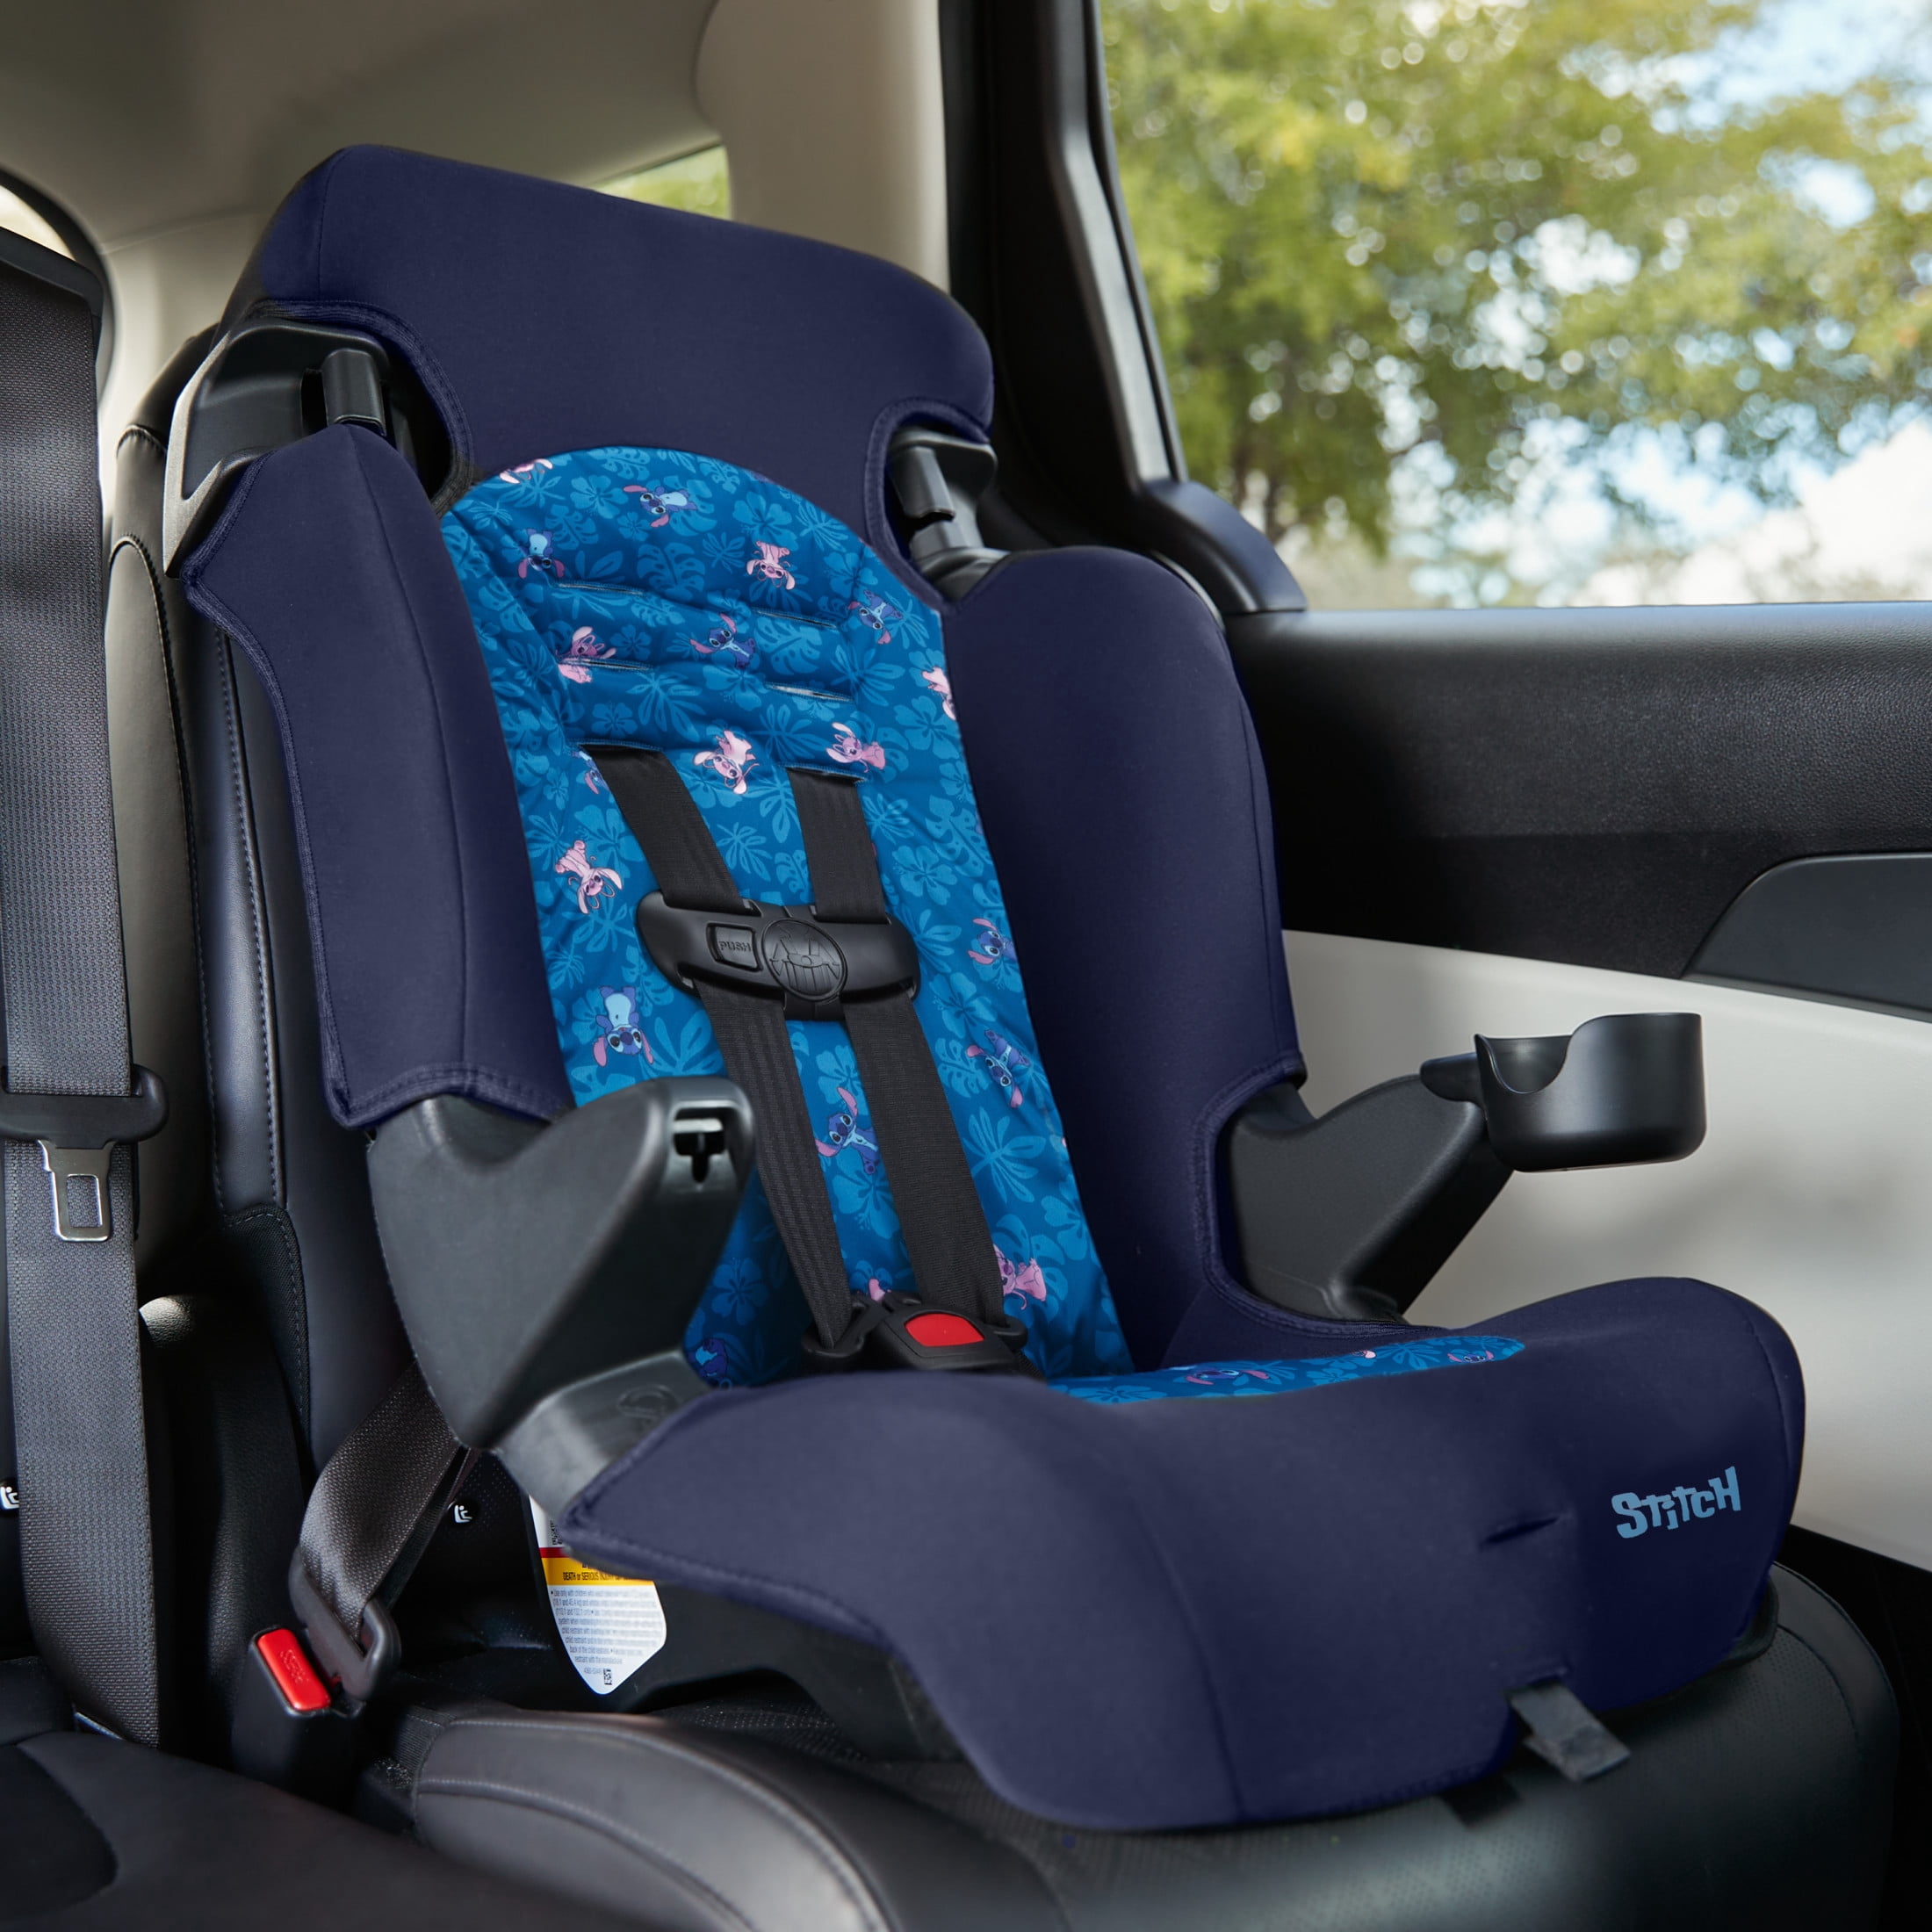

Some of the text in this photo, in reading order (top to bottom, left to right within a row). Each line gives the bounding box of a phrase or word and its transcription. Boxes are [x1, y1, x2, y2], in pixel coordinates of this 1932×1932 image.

[718, 941, 752, 952] PUSH
[563, 1572, 576, 1581] DEATH
[581, 1572, 599, 1581] SERIOUS
